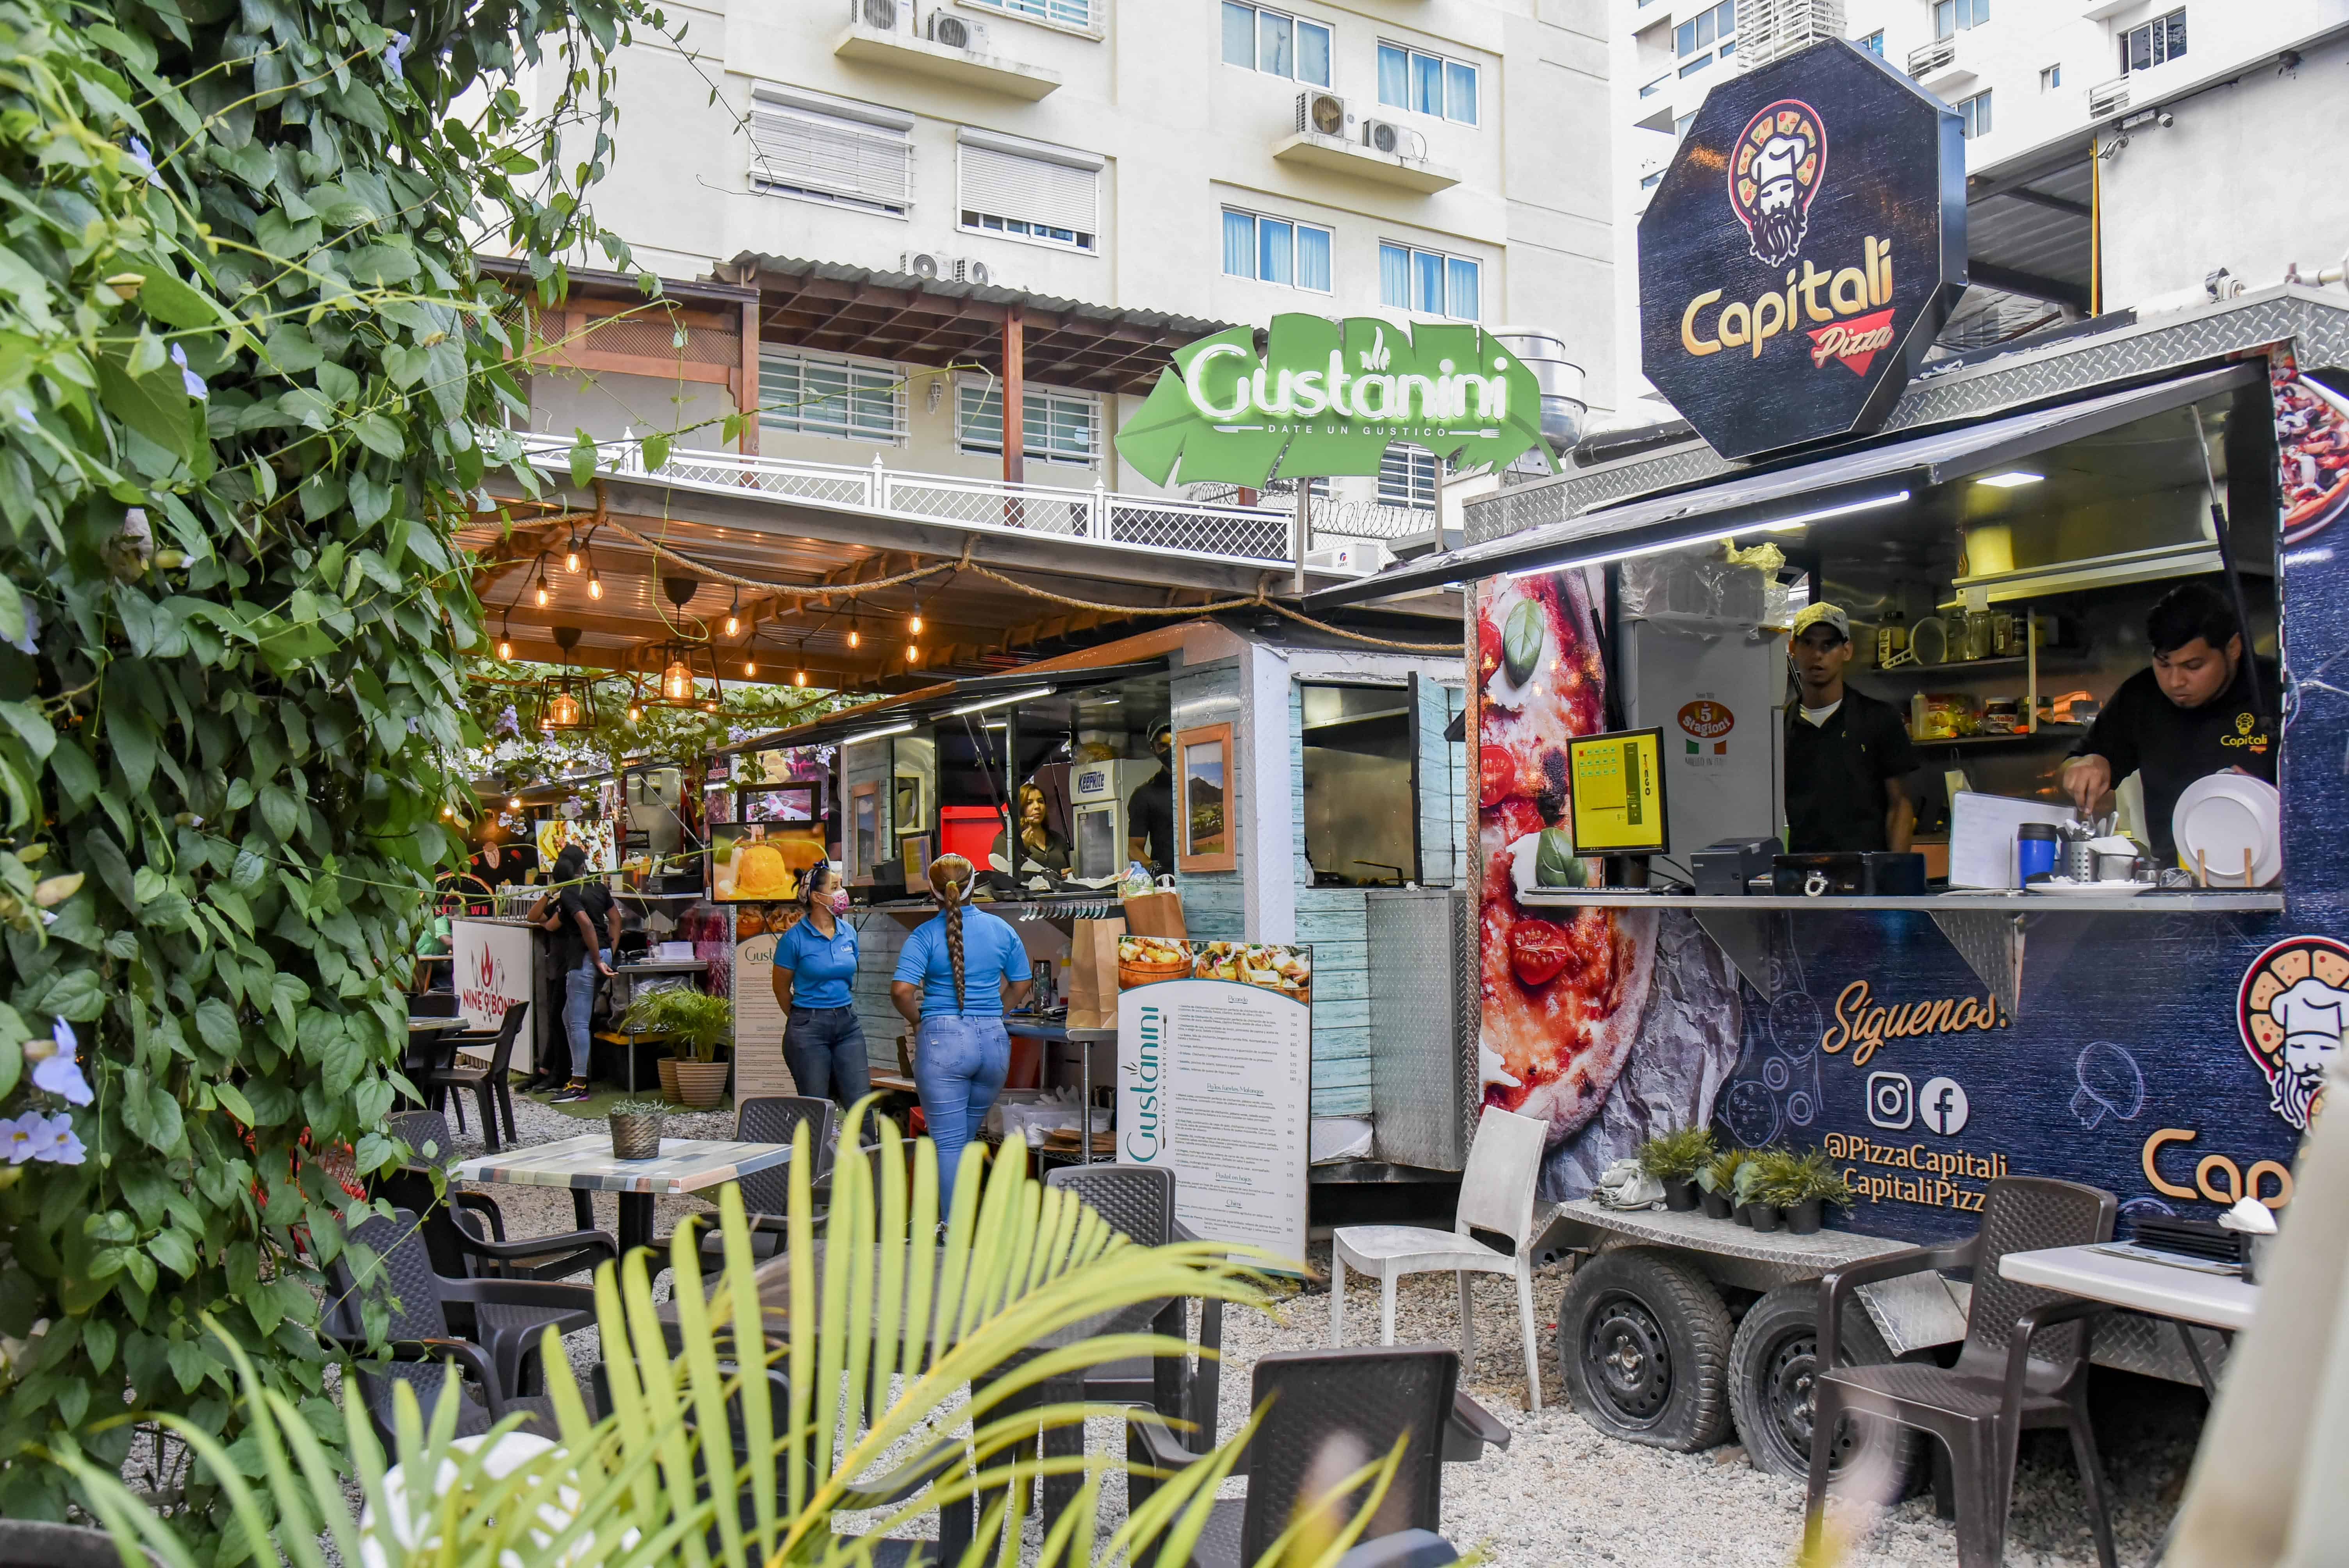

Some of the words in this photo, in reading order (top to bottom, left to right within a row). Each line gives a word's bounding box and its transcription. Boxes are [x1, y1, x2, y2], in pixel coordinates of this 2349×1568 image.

[1681, 235, 1893, 358] Capitali
[1814, 324, 1893, 366] Pizza
[1185, 343, 1508, 420] Gustanini
[1268, 424, 1313, 434] DATE
[1327, 426, 1348, 435] UN
[1363, 427, 1446, 437] GUSTICO
[1682, 715, 1731, 737] Stagioni
[1700, 707, 1712, 722] 5
[1988, 714, 2014, 722] nutella
[2220, 734, 2267, 747] Capitali
[745, 946, 773, 961] Gust
[463, 988, 483, 1011] NINE
[484, 992, 489, 1012] 9
[1126, 1007, 1158, 1162] Gustanini
[1162, 1085, 1167, 1096] UN
[1824, 1132, 2007, 1181] @PizzaCapitali
[2142, 1128, 2293, 1209] Cap
[1843, 1168, 1987, 1212] CapitaliPizz
